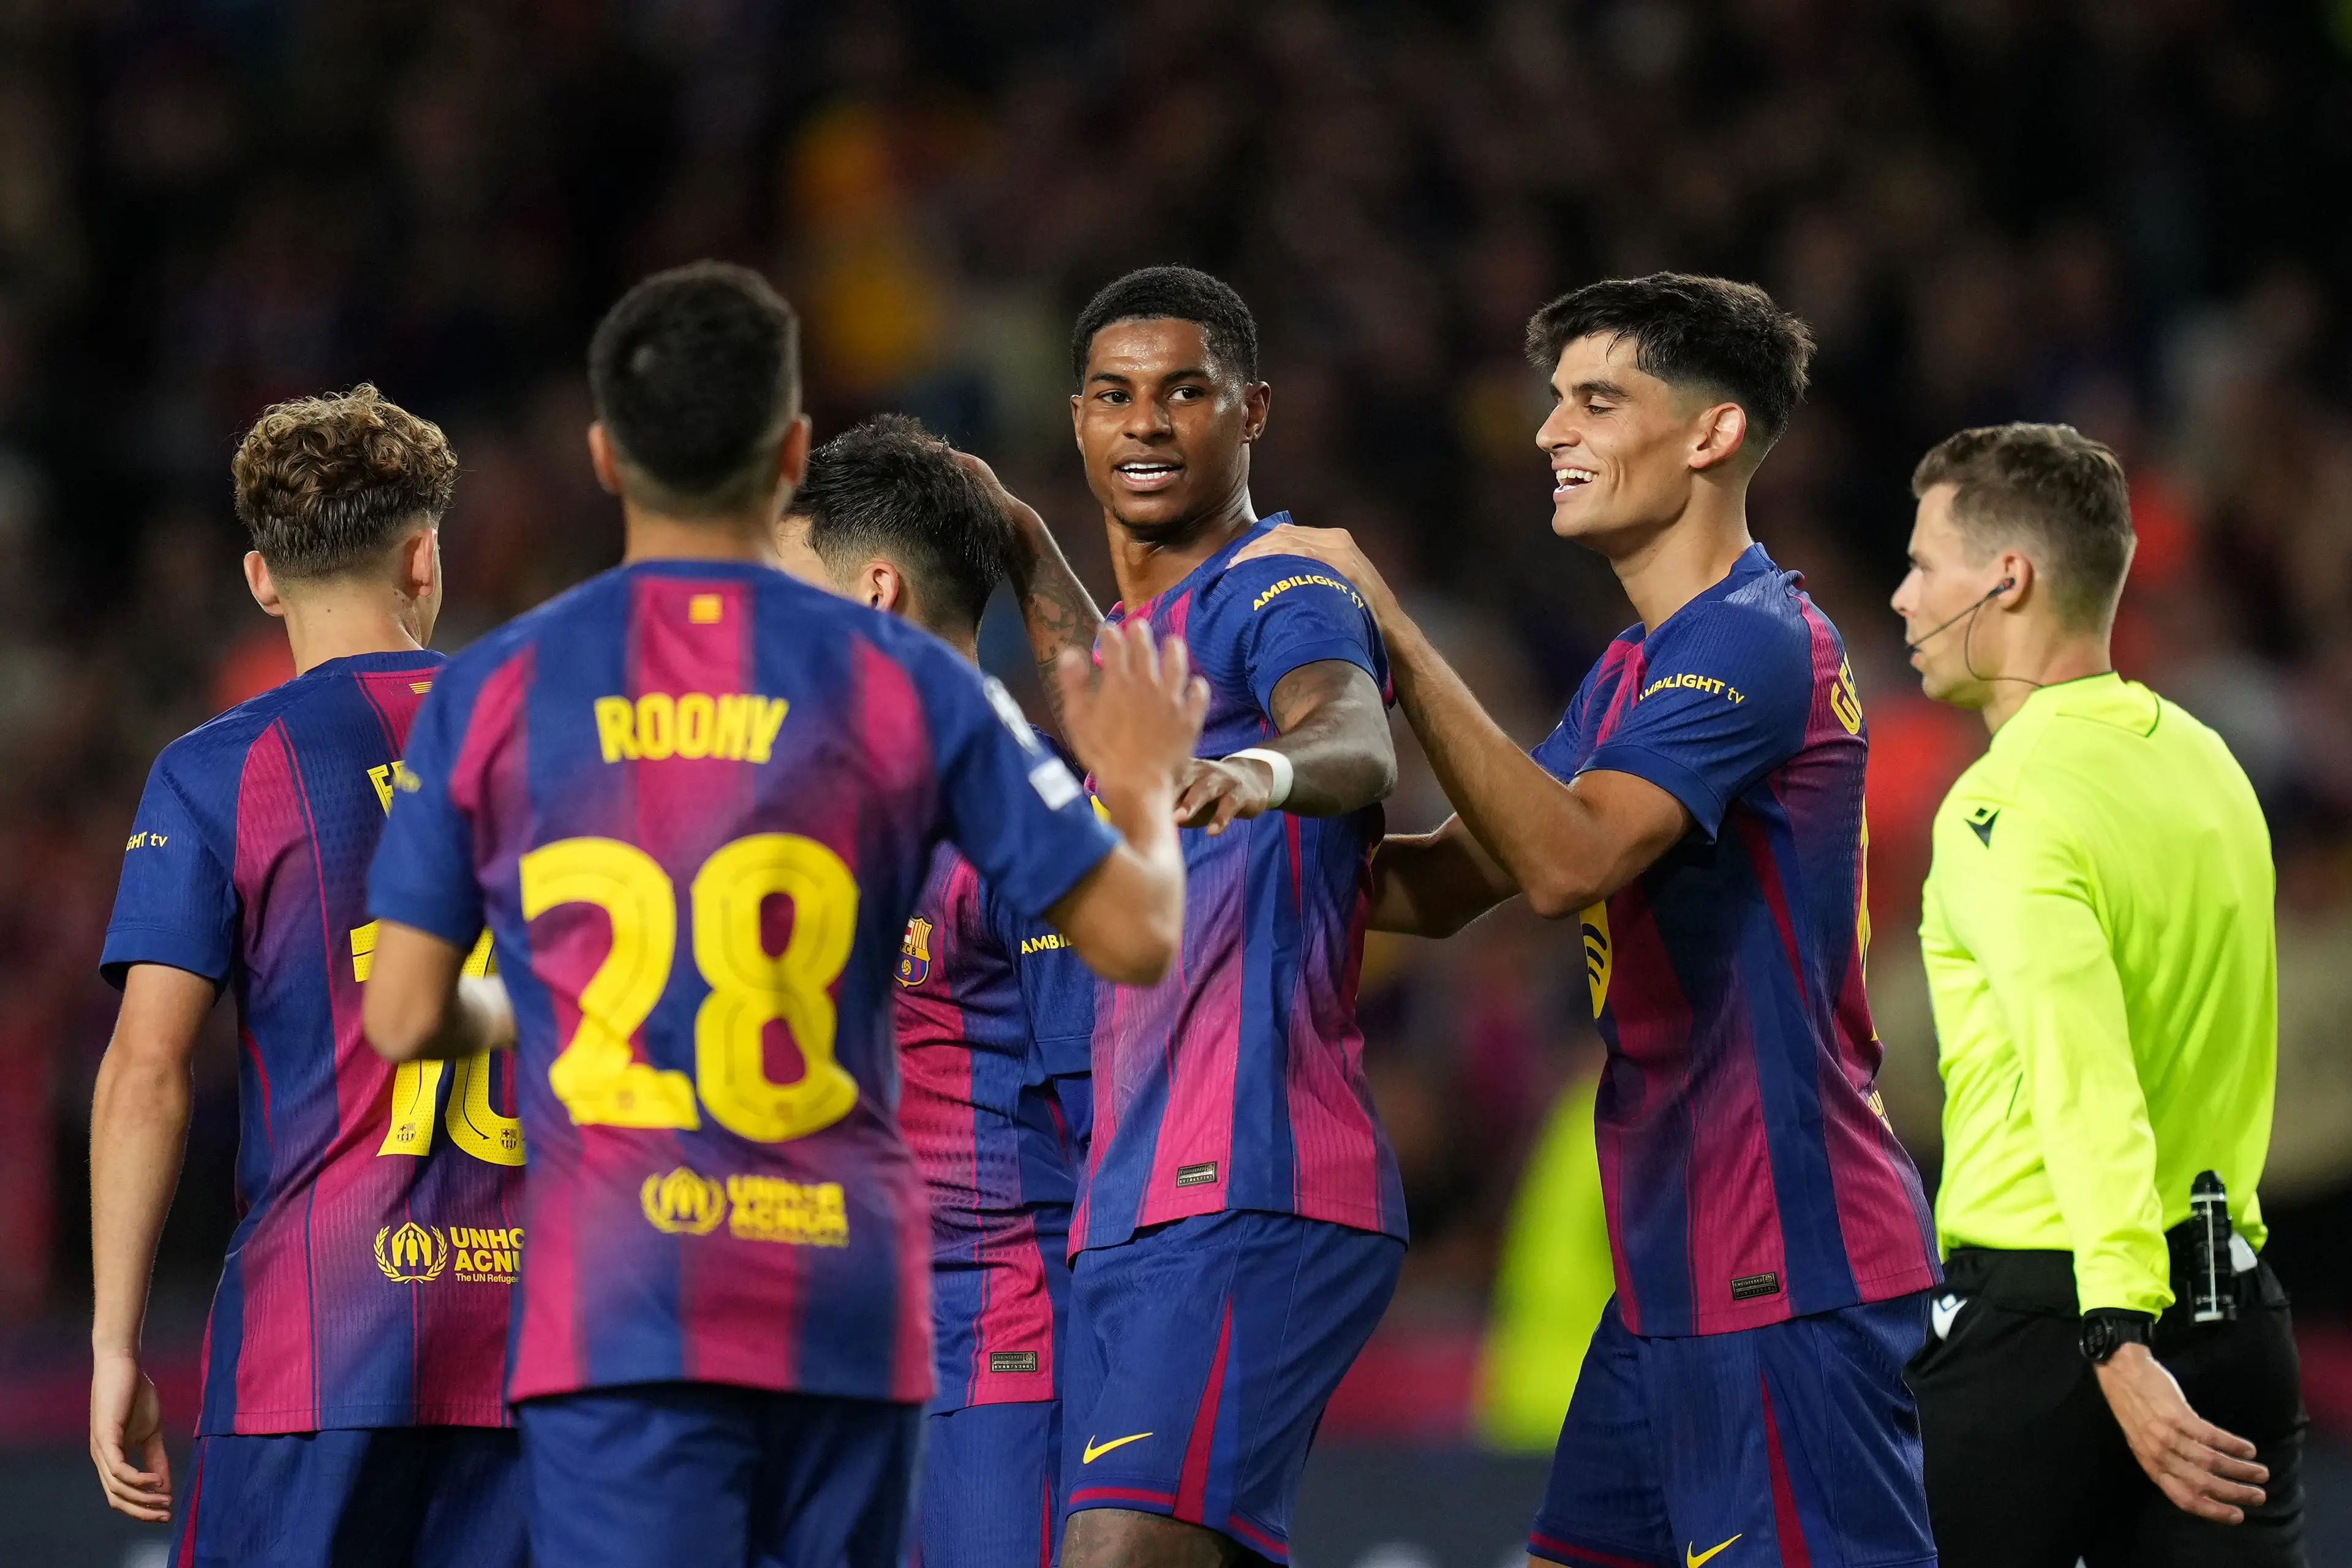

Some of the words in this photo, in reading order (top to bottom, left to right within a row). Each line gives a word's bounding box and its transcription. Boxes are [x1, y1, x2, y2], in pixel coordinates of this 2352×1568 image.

[1253, 575, 1348, 611] AMBILIGHT
[1727, 687, 1745, 704] tv
[594, 692, 790, 764] ROONY
[150, 833, 168, 847] tv
[518, 832, 861, 1143] 28
[450, 1227, 525, 1250] UNHC
[455, 1273, 472, 1282] The
[473, 1273, 486, 1282] UN
